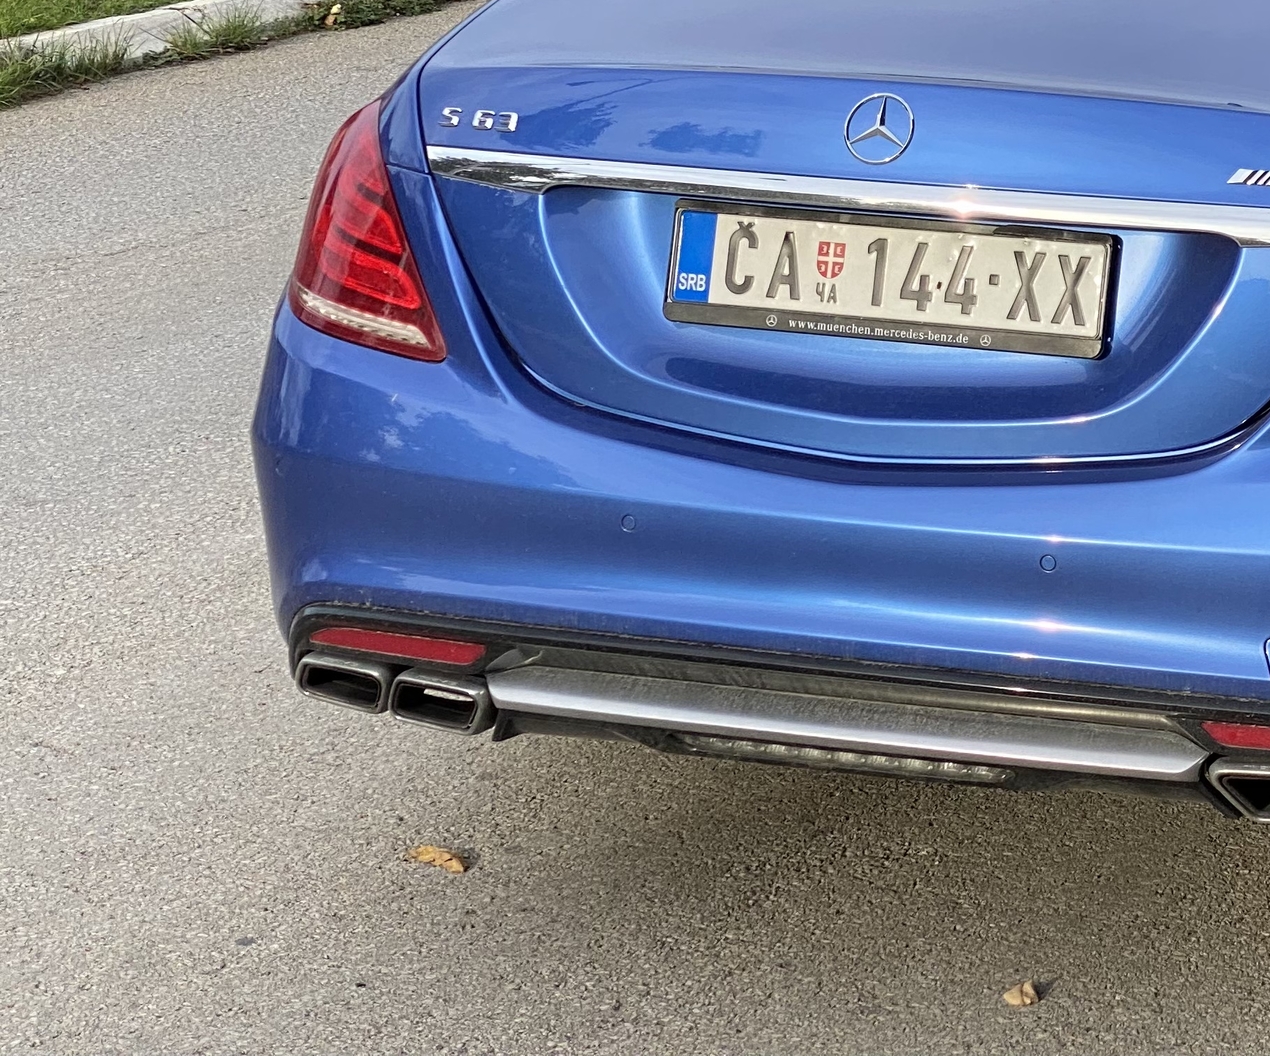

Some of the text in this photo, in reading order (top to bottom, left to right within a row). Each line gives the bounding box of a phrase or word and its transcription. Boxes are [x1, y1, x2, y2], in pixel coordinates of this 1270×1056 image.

[438, 106, 520, 133] S 63
[724, 221, 801, 302] ČA
[677, 272, 707, 293] SRB
[787, 317, 970, 346] www.muenchen.mercedes-benz.de
